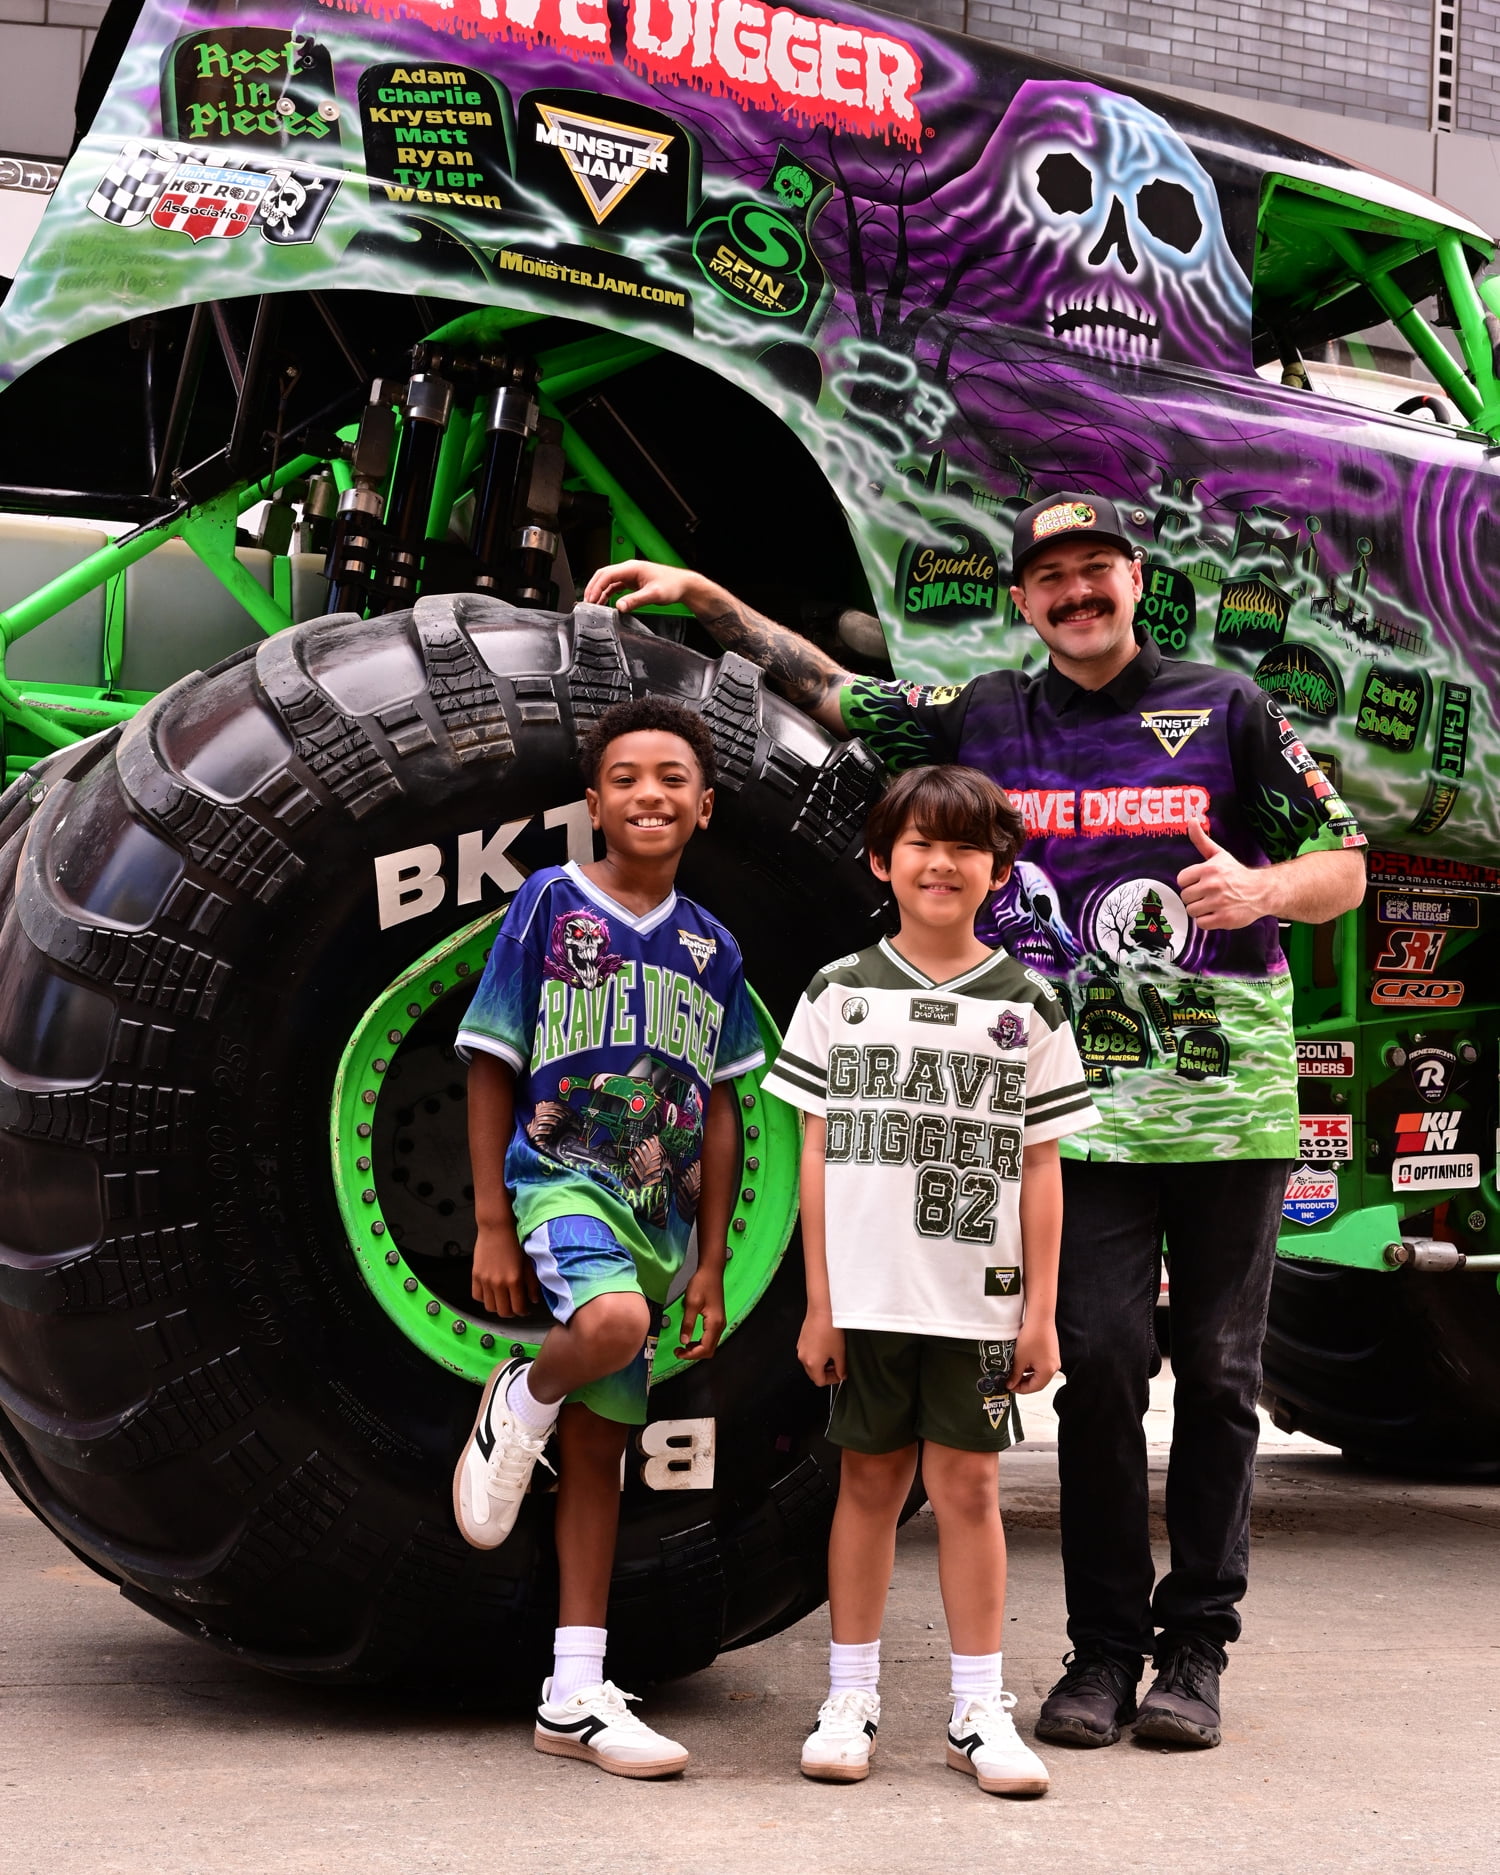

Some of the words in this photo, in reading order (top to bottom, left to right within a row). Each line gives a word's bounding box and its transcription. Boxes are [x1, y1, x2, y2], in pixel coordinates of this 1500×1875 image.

[193, 41, 306, 78] Rest
[631, 0, 917, 122] DIGGER
[391, 68, 467, 85] Adam
[234, 75, 276, 107] in
[378, 87, 482, 105] Charlie
[185, 101, 331, 139] Pieces
[369, 107, 493, 126] Krysten
[395, 127, 469, 145] Matt
[397, 147, 474, 168] Ryan
[535, 122, 669, 174] MONSTER
[394, 169, 484, 189] Tyler
[572, 155, 632, 185] JAM
[383, 185, 502, 210] Weston
[160, 200, 248, 222] Association
[716, 244, 785, 300] SPIN
[1037, 515, 1073, 533] DIGGER
[1038, 507, 1070, 524] GRAVE
[913, 549, 994, 582] Sparkle
[906, 581, 994, 613] SMASH
[1134, 593, 1189, 625] oro
[1218, 606, 1284, 638] DRAGON
[1137, 618, 1187, 650] co
[1366, 677, 1418, 715] Earth
[1140, 717, 1210, 729] MONSTER
[1159, 727, 1192, 739] JAM
[1358, 706, 1415, 741] Shaker
[1005, 790, 1076, 831] RAVE
[1082, 788, 1208, 827] DIGGER
[374, 799, 594, 931] BKT
[1412, 901, 1442, 913] ENERGY
[679, 936, 717, 954] MONSTER
[1089, 987, 1115, 999] RIP
[642, 962, 725, 1081] DIGGE
[1081, 1032, 1142, 1054] 1982
[1183, 1040, 1219, 1059] Earth
[1296, 1044, 1338, 1059] COLN
[1106, 1054, 1140, 1062] ANDERSON
[1180, 1056, 1221, 1073] Shaker
[1298, 1062, 1345, 1074] ELDERS
[827, 1045, 1027, 1115] GRAVE
[825, 1108, 1024, 1182] DIGGER
[1299, 1139, 1348, 1148] ROD
[1299, 1149, 1348, 1158] NDS
[1284, 1184, 1334, 1199] LUCAS
[914, 1162, 1000, 1246] 82
[1295, 1202, 1335, 1210] PRODUCTS
